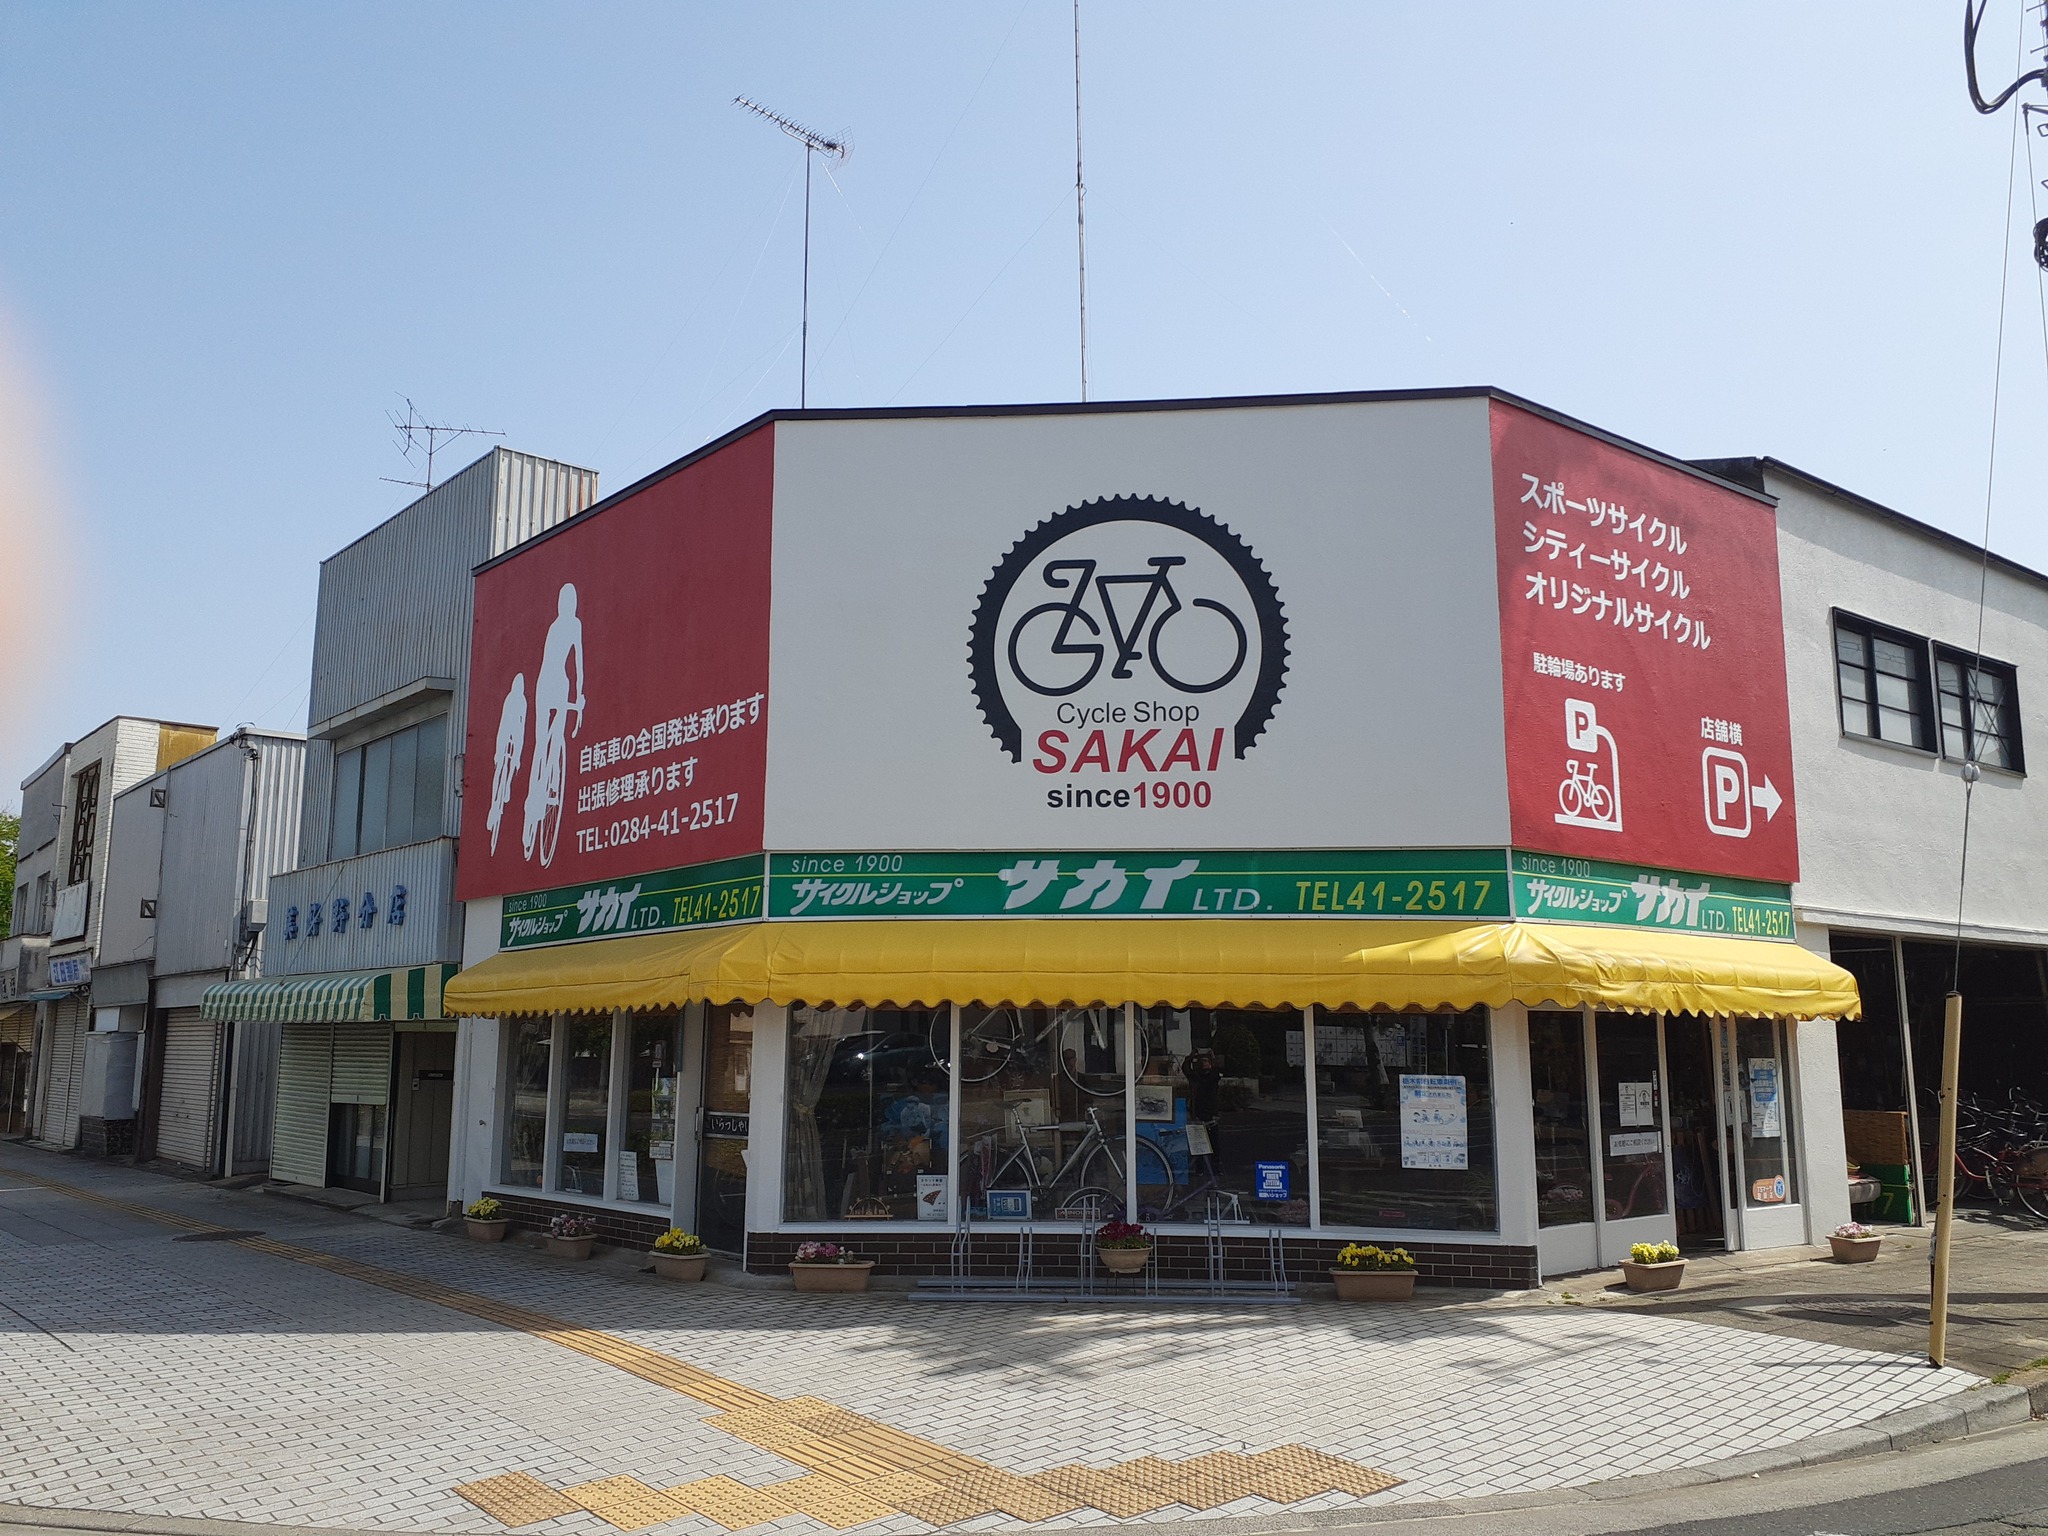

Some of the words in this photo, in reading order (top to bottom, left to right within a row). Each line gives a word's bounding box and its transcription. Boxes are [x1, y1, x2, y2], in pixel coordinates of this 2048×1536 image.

[1520, 473, 1687, 556] スポーツサイクル
[1522, 520, 1690, 600] シティーサイクル
[1525, 572, 1711, 650] オリジナルサイクル
[1533, 652, 1626, 692] 駐輪場あります
[580, 692, 764, 774] 自転車の全国発送承ります
[1056, 702, 1126, 729] Cycle
[1134, 701, 1200, 727] Shop
[1701, 716, 1743, 746] 店舗横
[1032, 728, 1224, 774] SAKAI
[578, 756, 698, 814] 出張修理承ります
[577, 793, 738, 854] TEL:0284-41-2517
[790, 878, 964, 915] サイクルショップ
[998, 859, 1200, 910] サカイ
[1192, 888, 1273, 912] LTD.
[792, 856, 845, 873] since
[855, 855, 902, 872] 1900
[1522, 854, 1556, 874] since
[1561, 859, 1590, 878] 1900
[508, 900, 527, 913] since
[530, 893, 547, 908] 1900
[508, 910, 568, 946] サイクルショップ
[577, 882, 642, 934] サカイ
[631, 906, 666, 928] LTD.
[1526, 878, 1627, 914] サイクルショップ
[1631, 874, 1710, 927] サカイ
[1702, 910, 1730, 932] LTD.
